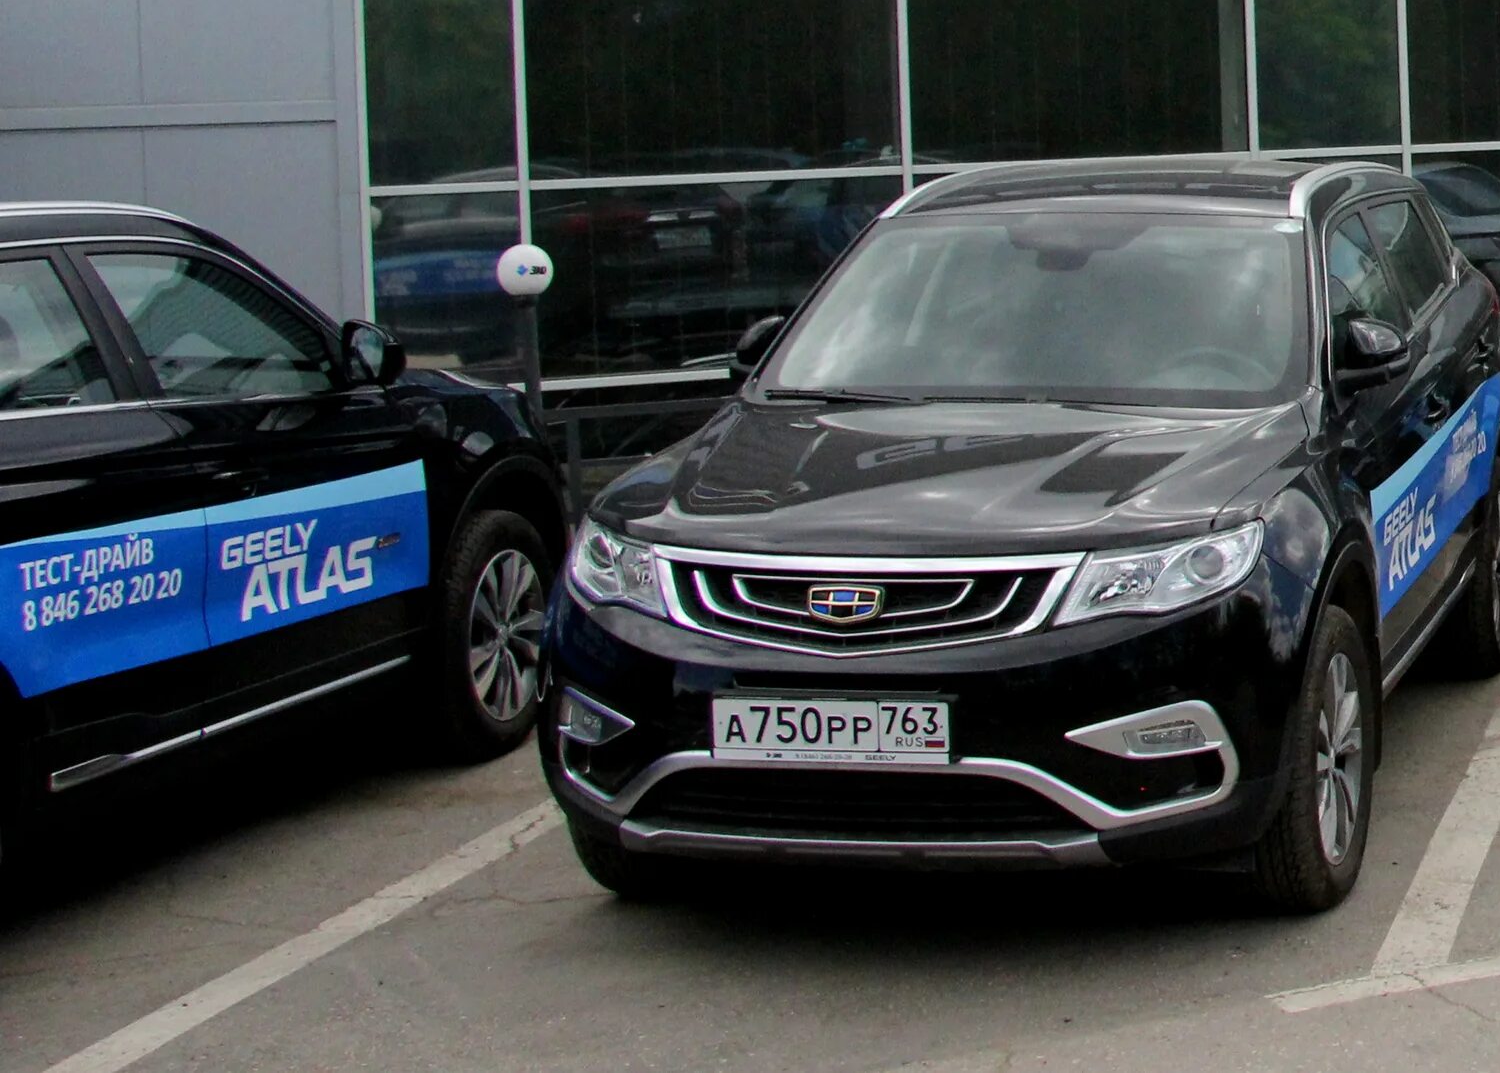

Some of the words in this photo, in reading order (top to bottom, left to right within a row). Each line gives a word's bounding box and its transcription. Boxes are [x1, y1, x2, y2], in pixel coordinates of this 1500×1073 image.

[221, 518, 318, 570] GEELY
[1384, 486, 1420, 547] GEELY
[1388, 494, 1437, 592] ATLAS
[19, 532, 154, 591] ТЕСТ-ДРАЙВ
[241, 536, 377, 622] ATLAS
[23, 599, 37, 632] 8
[41, 590, 80, 626] 846
[84, 579, 124, 616] 268
[128, 573, 154, 605] 20
[156, 568, 182, 600] 20
[725, 706, 872, 744] А750РР
[881, 706, 938, 735] 763
[895, 737, 924, 747] RUS
